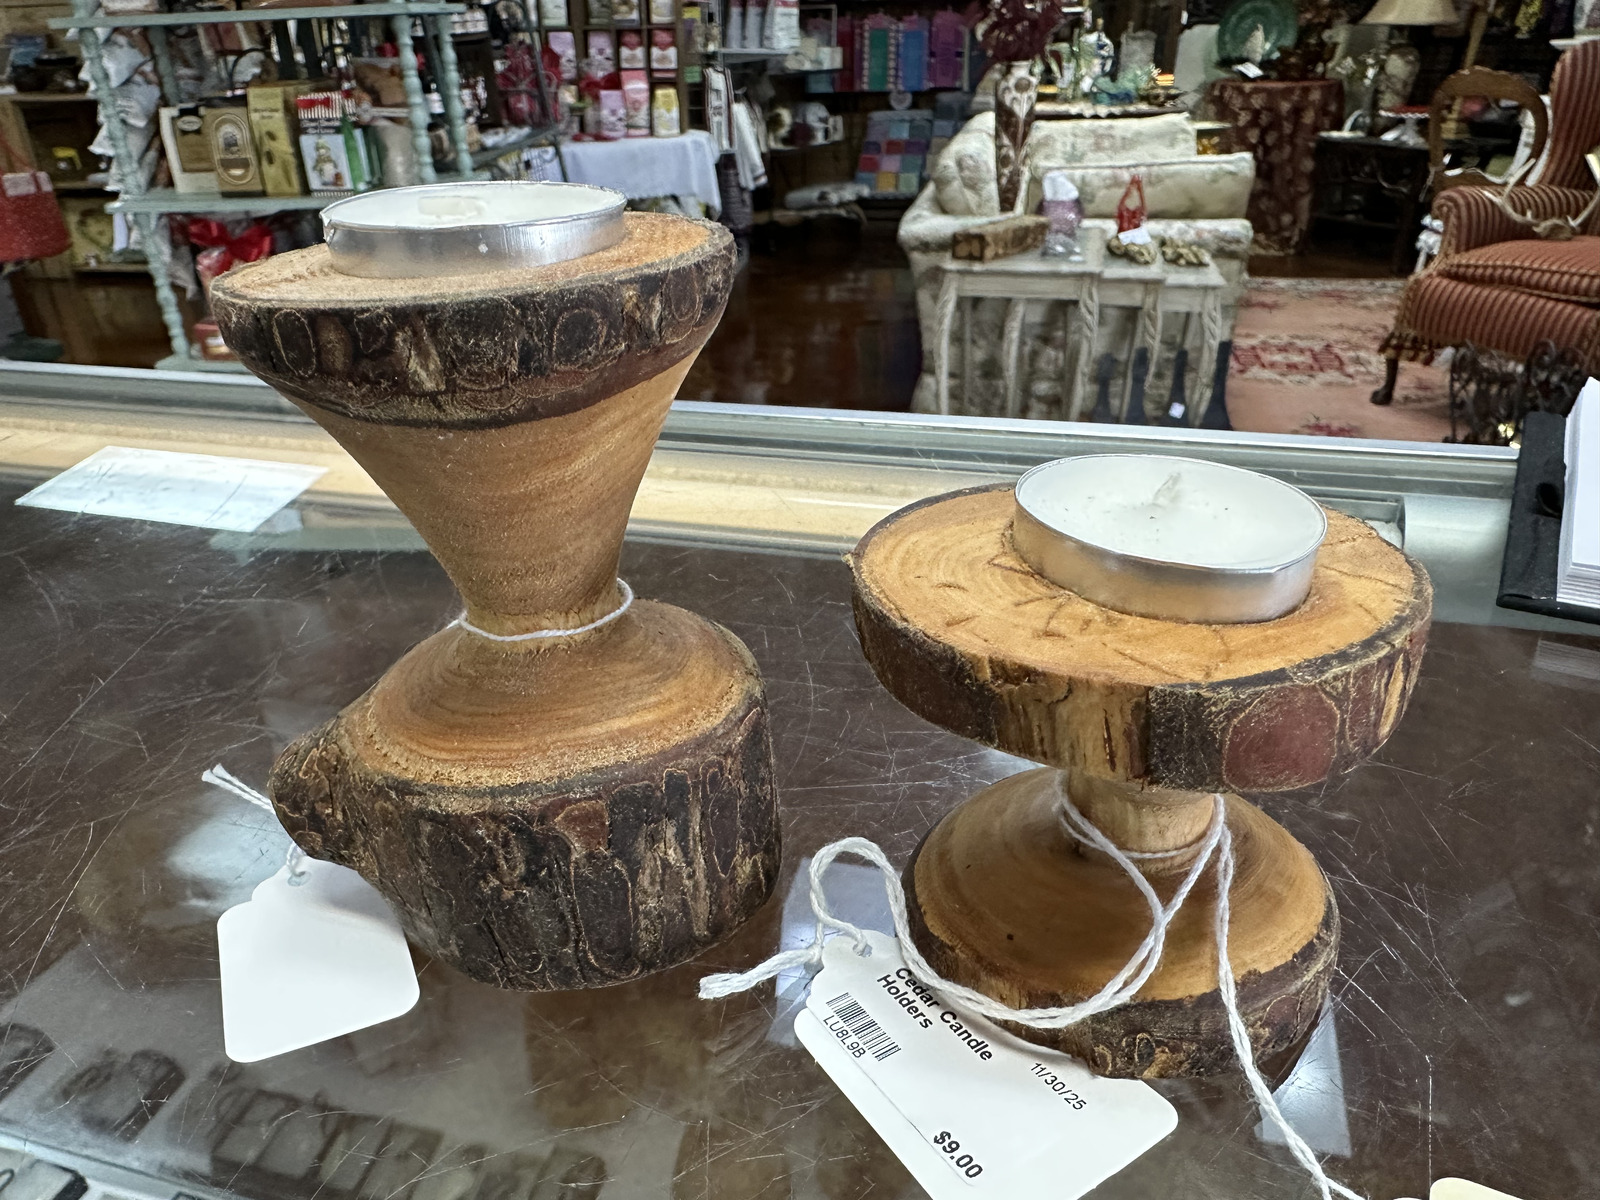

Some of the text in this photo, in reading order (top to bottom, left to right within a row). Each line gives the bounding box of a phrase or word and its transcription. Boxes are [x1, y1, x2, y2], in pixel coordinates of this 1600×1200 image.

[877, 974, 933, 1029] Holders
[896, 968, 993, 1061] Cedar Candle
[823, 1014, 866, 1059] LU8L9B
[1031, 1062, 1087, 1110] 11/30/25
[933, 1131, 983, 1179] $9.00
